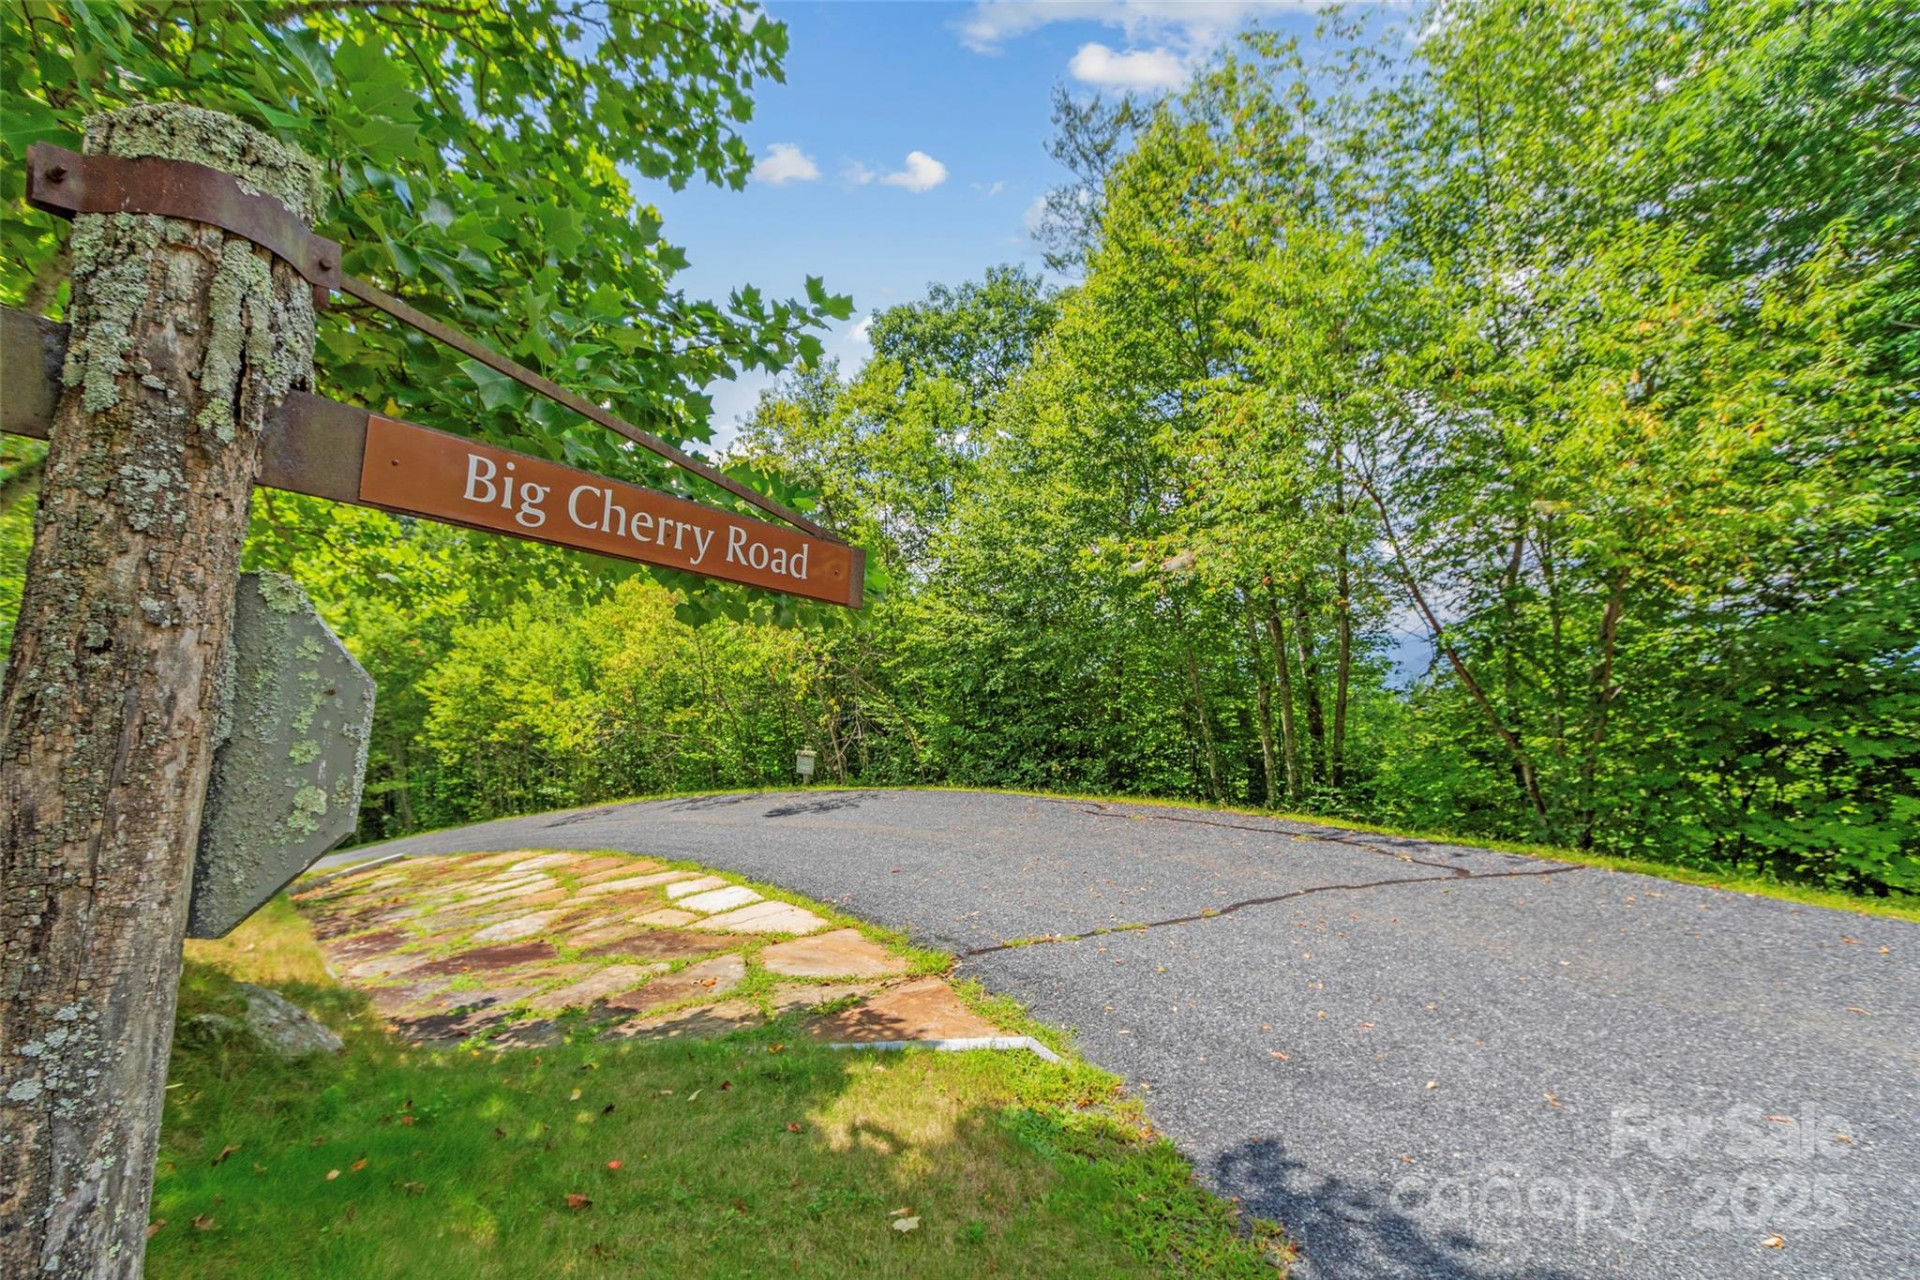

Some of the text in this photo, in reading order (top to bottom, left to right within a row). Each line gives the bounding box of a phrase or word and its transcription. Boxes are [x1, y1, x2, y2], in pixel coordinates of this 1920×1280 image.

[463, 453, 809, 580] Big Cherry Road
